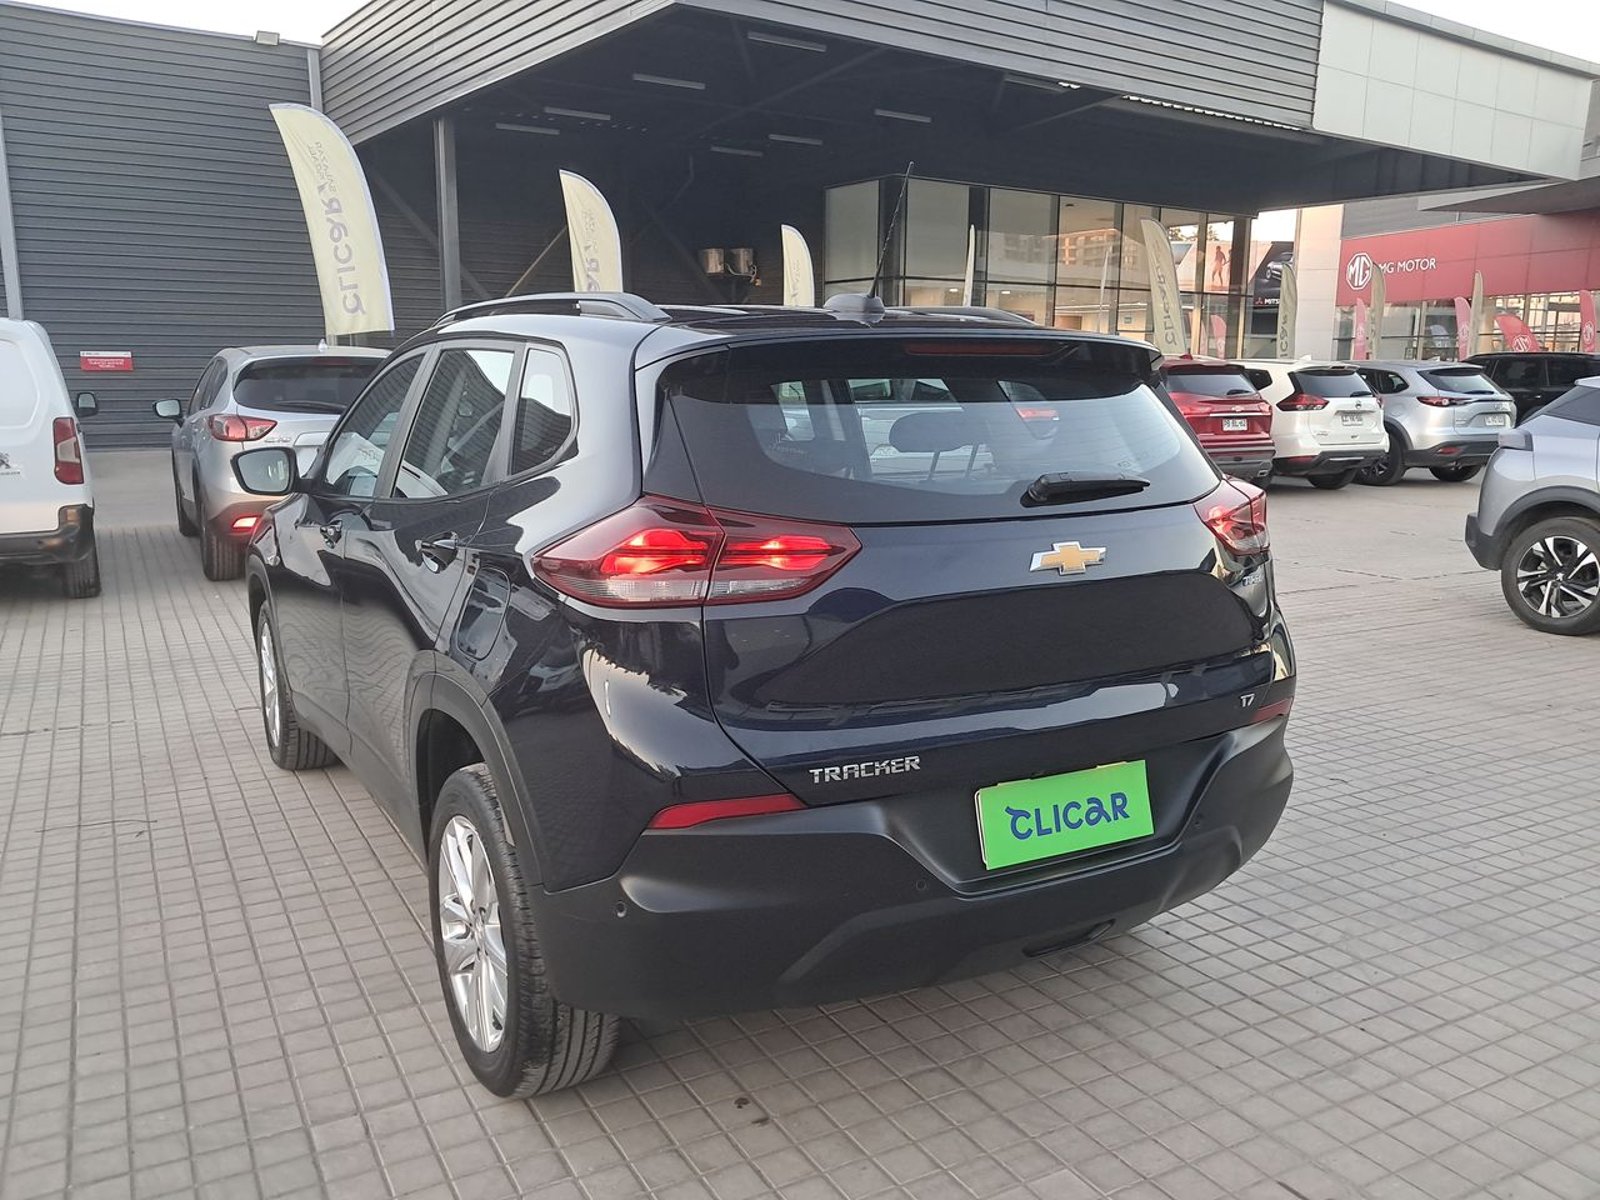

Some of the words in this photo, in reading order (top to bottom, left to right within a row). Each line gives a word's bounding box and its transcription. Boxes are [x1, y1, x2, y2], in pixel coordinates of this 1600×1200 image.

[1348, 255, 1371, 287] MG
[1397, 257, 1436, 273] MOTOR
[809, 755, 921, 784] TRACKER
